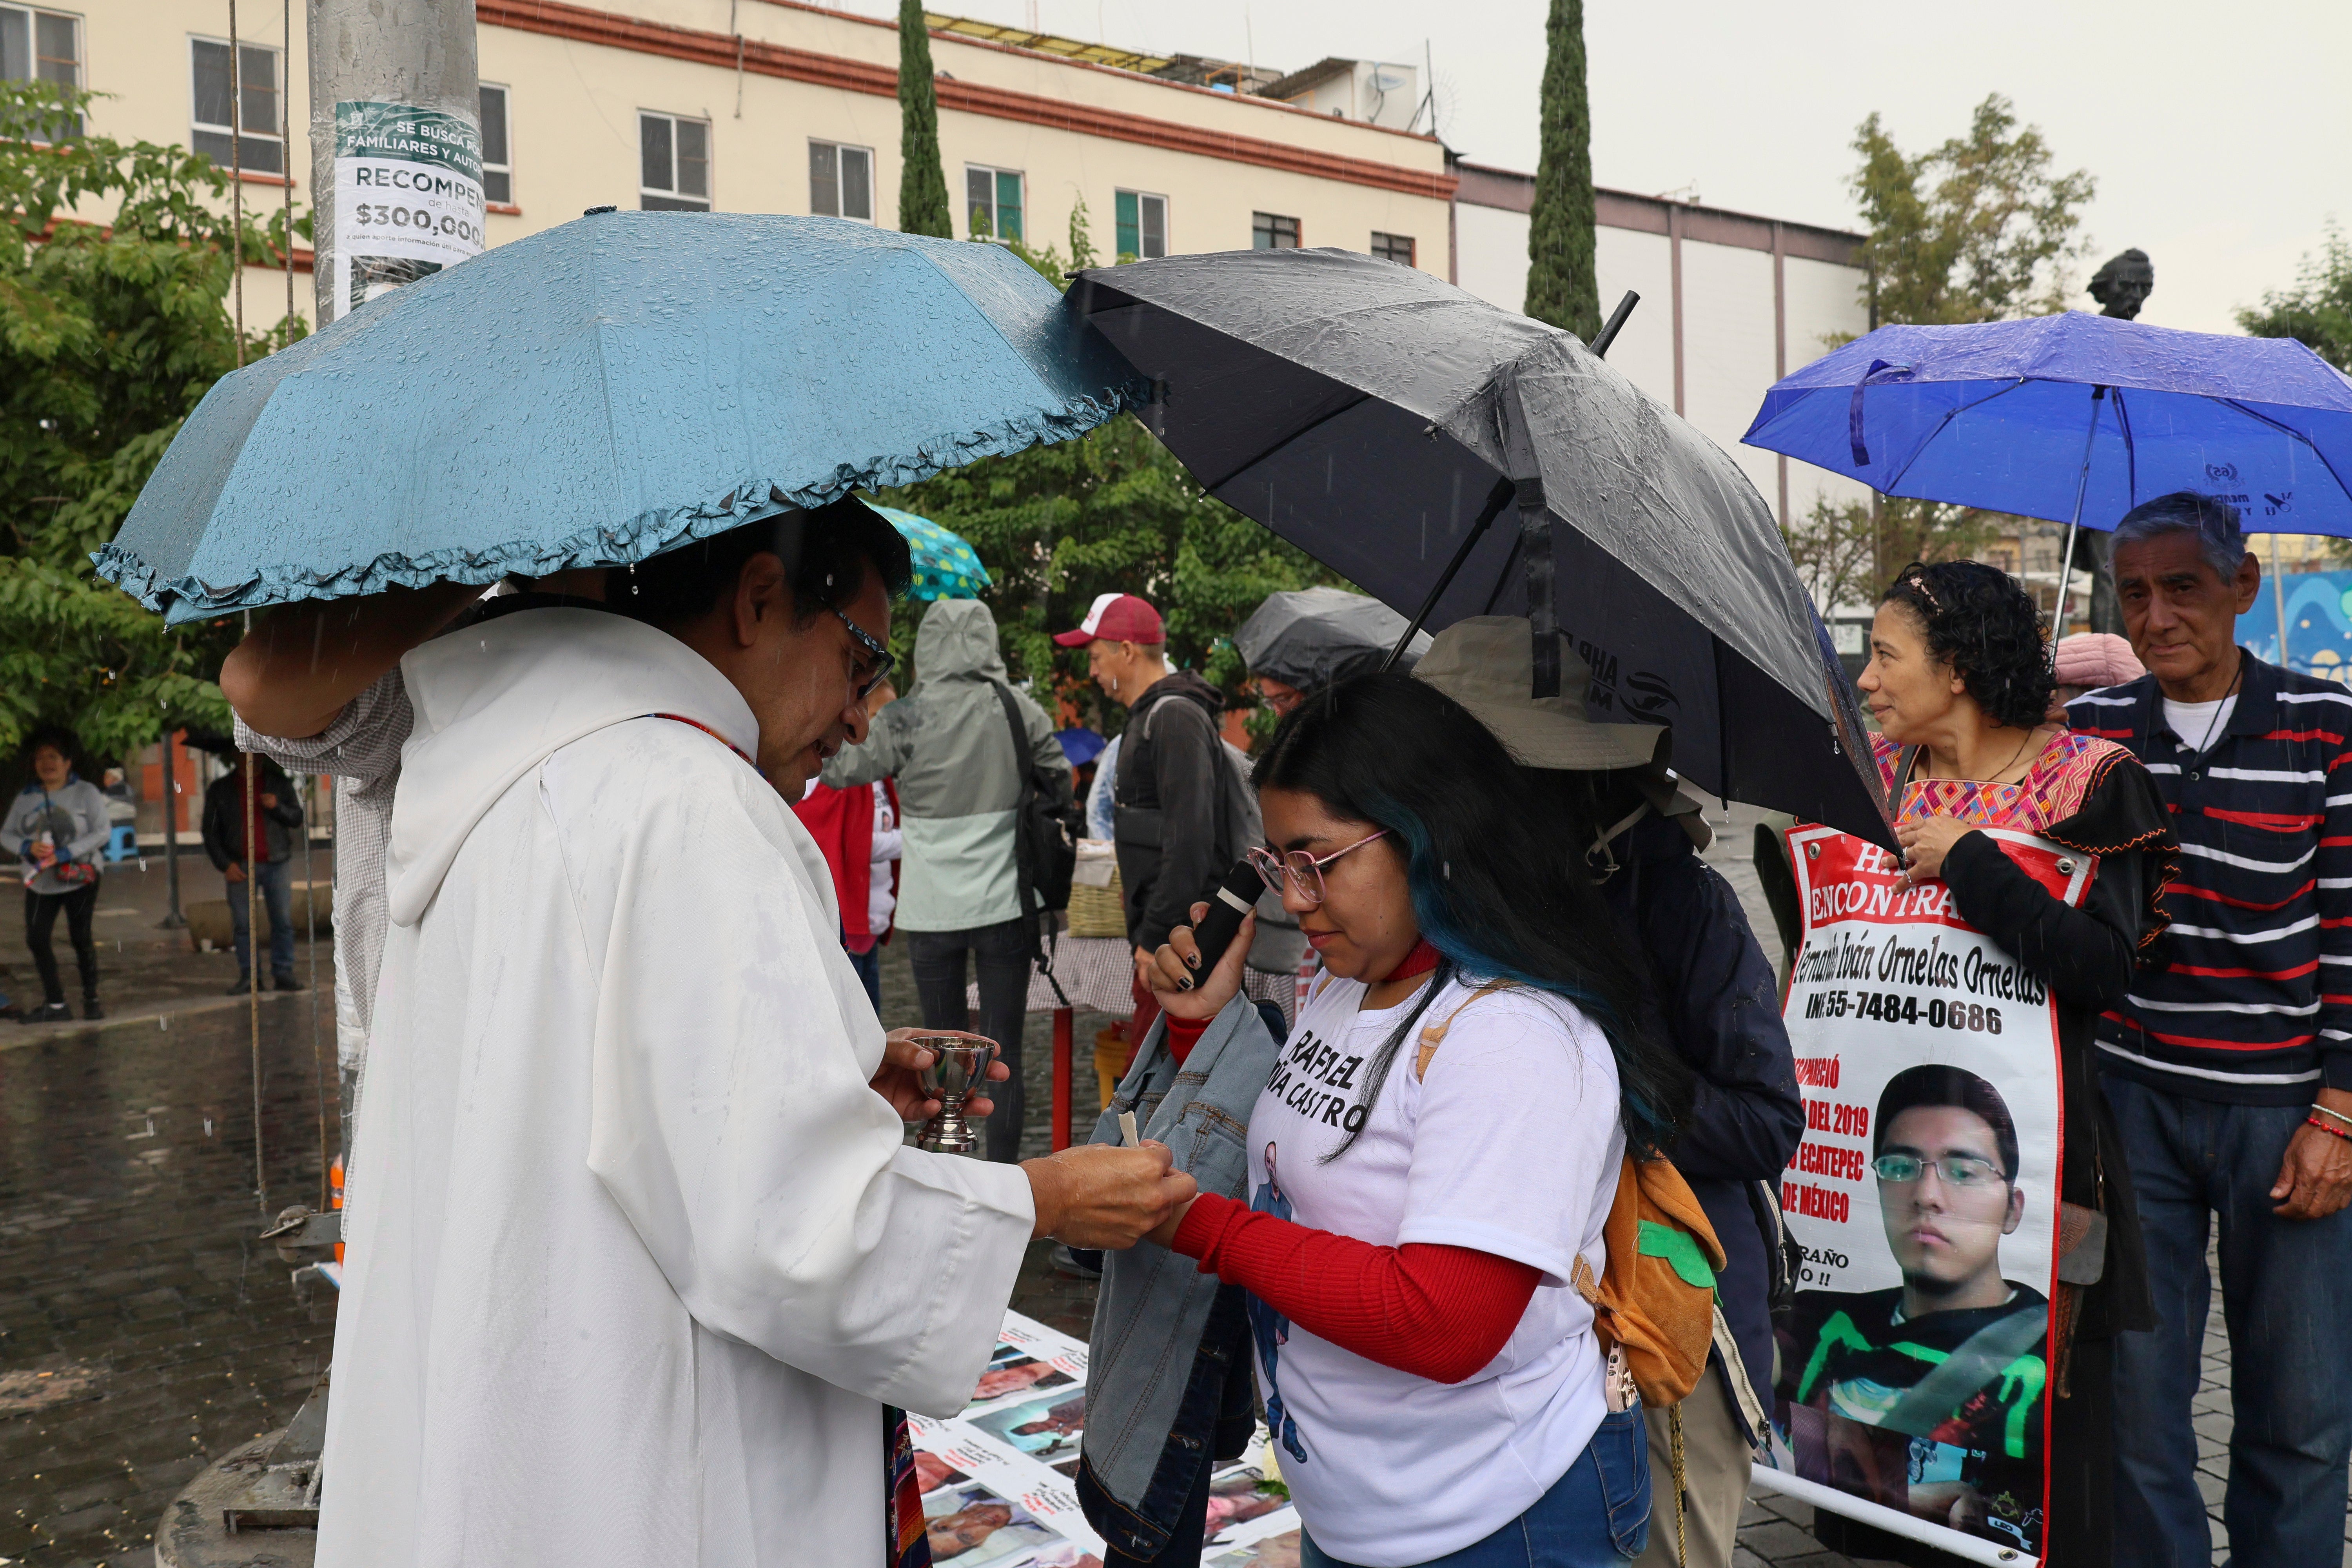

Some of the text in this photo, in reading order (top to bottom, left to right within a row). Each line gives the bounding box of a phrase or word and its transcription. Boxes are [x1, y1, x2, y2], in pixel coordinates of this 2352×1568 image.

[347, 136, 438, 156] FAMILIARES
[441, 147, 450, 159] Y
[397, 121, 416, 134] SE
[421, 125, 464, 148] BUSCA
[357, 167, 486, 214] RECOMPEN
[428, 198, 469, 217] de hasta
[397, 236, 439, 247] información
[442, 242, 451, 250] útil
[1811, 880, 1965, 921] ENCONTRA
[1836, 929, 1875, 980] Iván
[1878, 934, 1958, 989] Ornelas
[1964, 946, 2046, 1007] Ornelas
[1826, 990, 2002, 1035] 55-7484-0686
[1286, 1082, 1368, 1132] CASTRO
[1808, 1099, 1831, 1129] DEL
[1833, 1103, 1869, 1138] 2019
[1800, 1142, 1864, 1181] ECATEPEC
[1782, 1181, 1849, 1223] DE MÉXICO
[1798, 1245, 1849, 1269] RAÑO
